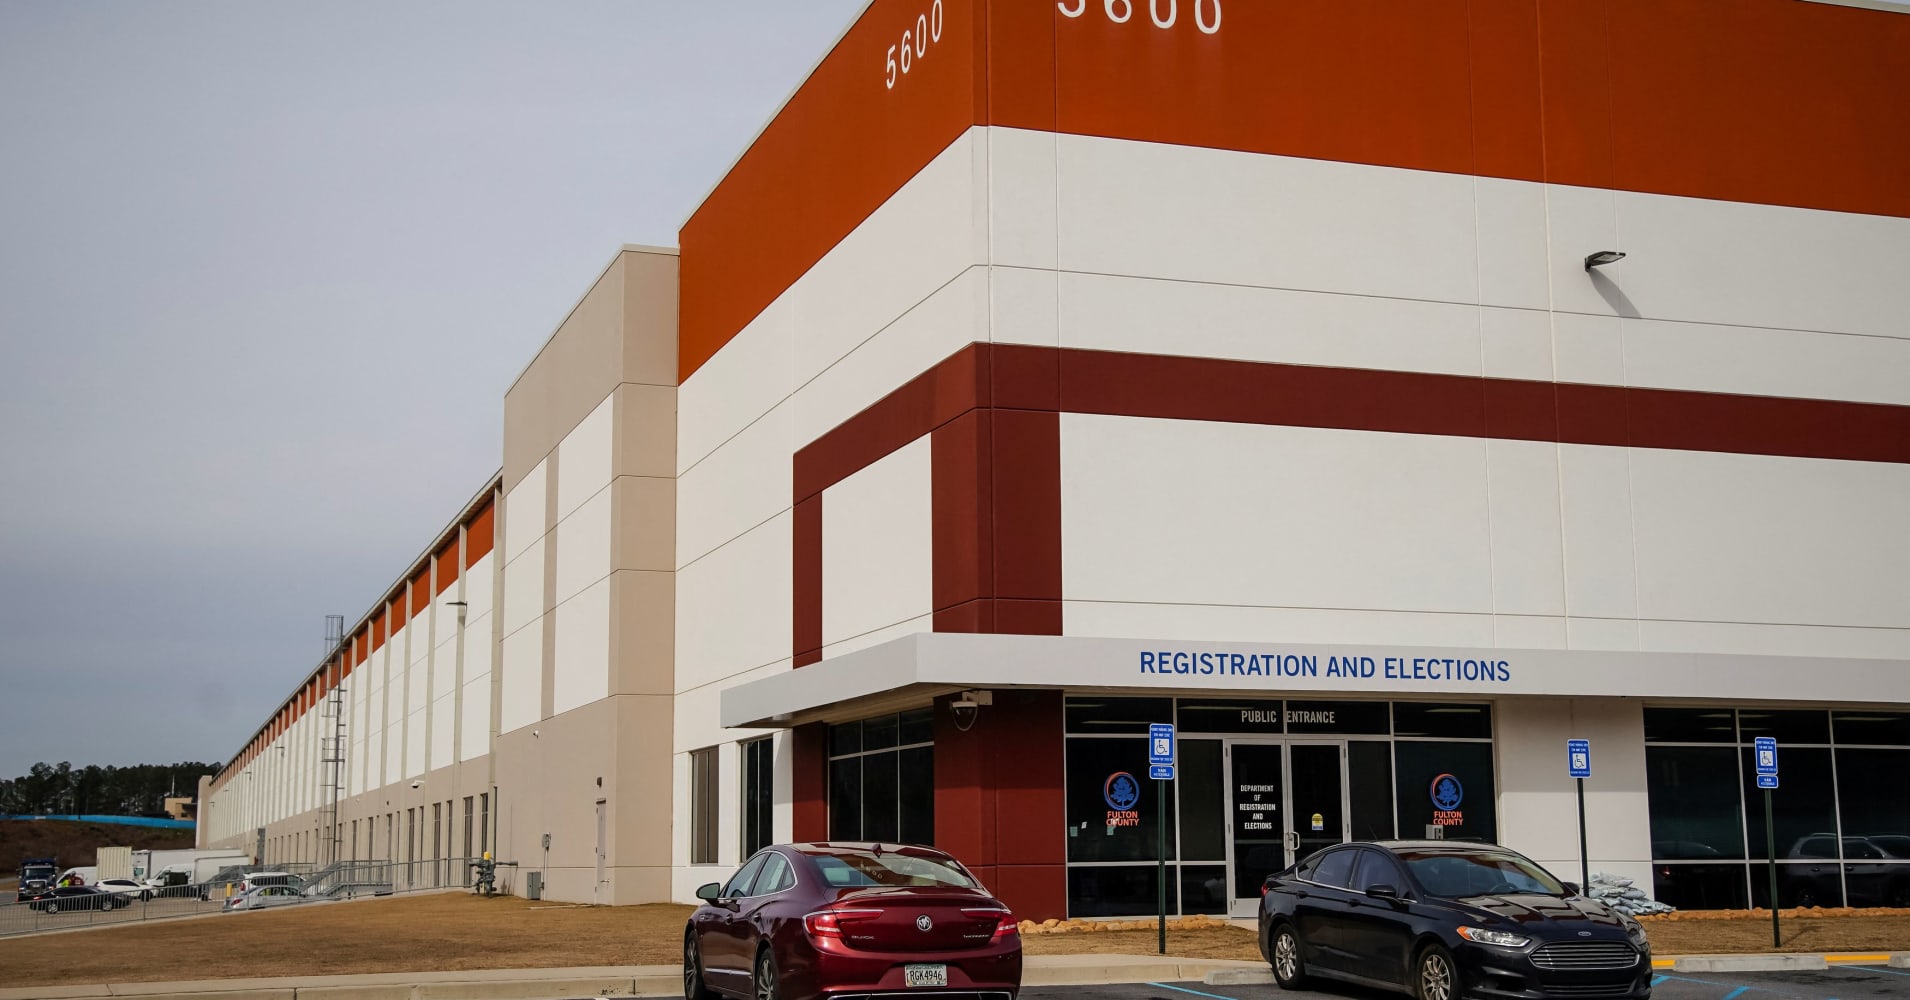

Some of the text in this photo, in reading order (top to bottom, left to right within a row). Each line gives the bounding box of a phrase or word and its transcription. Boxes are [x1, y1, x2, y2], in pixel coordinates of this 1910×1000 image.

[886, 0, 943, 89] 5600
[1140, 651, 1510, 682] REGISTRATION AND ELECTIONS
[1241, 710, 1335, 723] PUBLIC ENTRANCE
[1106, 818, 1139, 826] COUNTY
[1244, 822, 1272, 830] ELECTIONS
[1433, 818, 1463, 826] COUNTY
[909, 970, 943, 981] RGK4946
